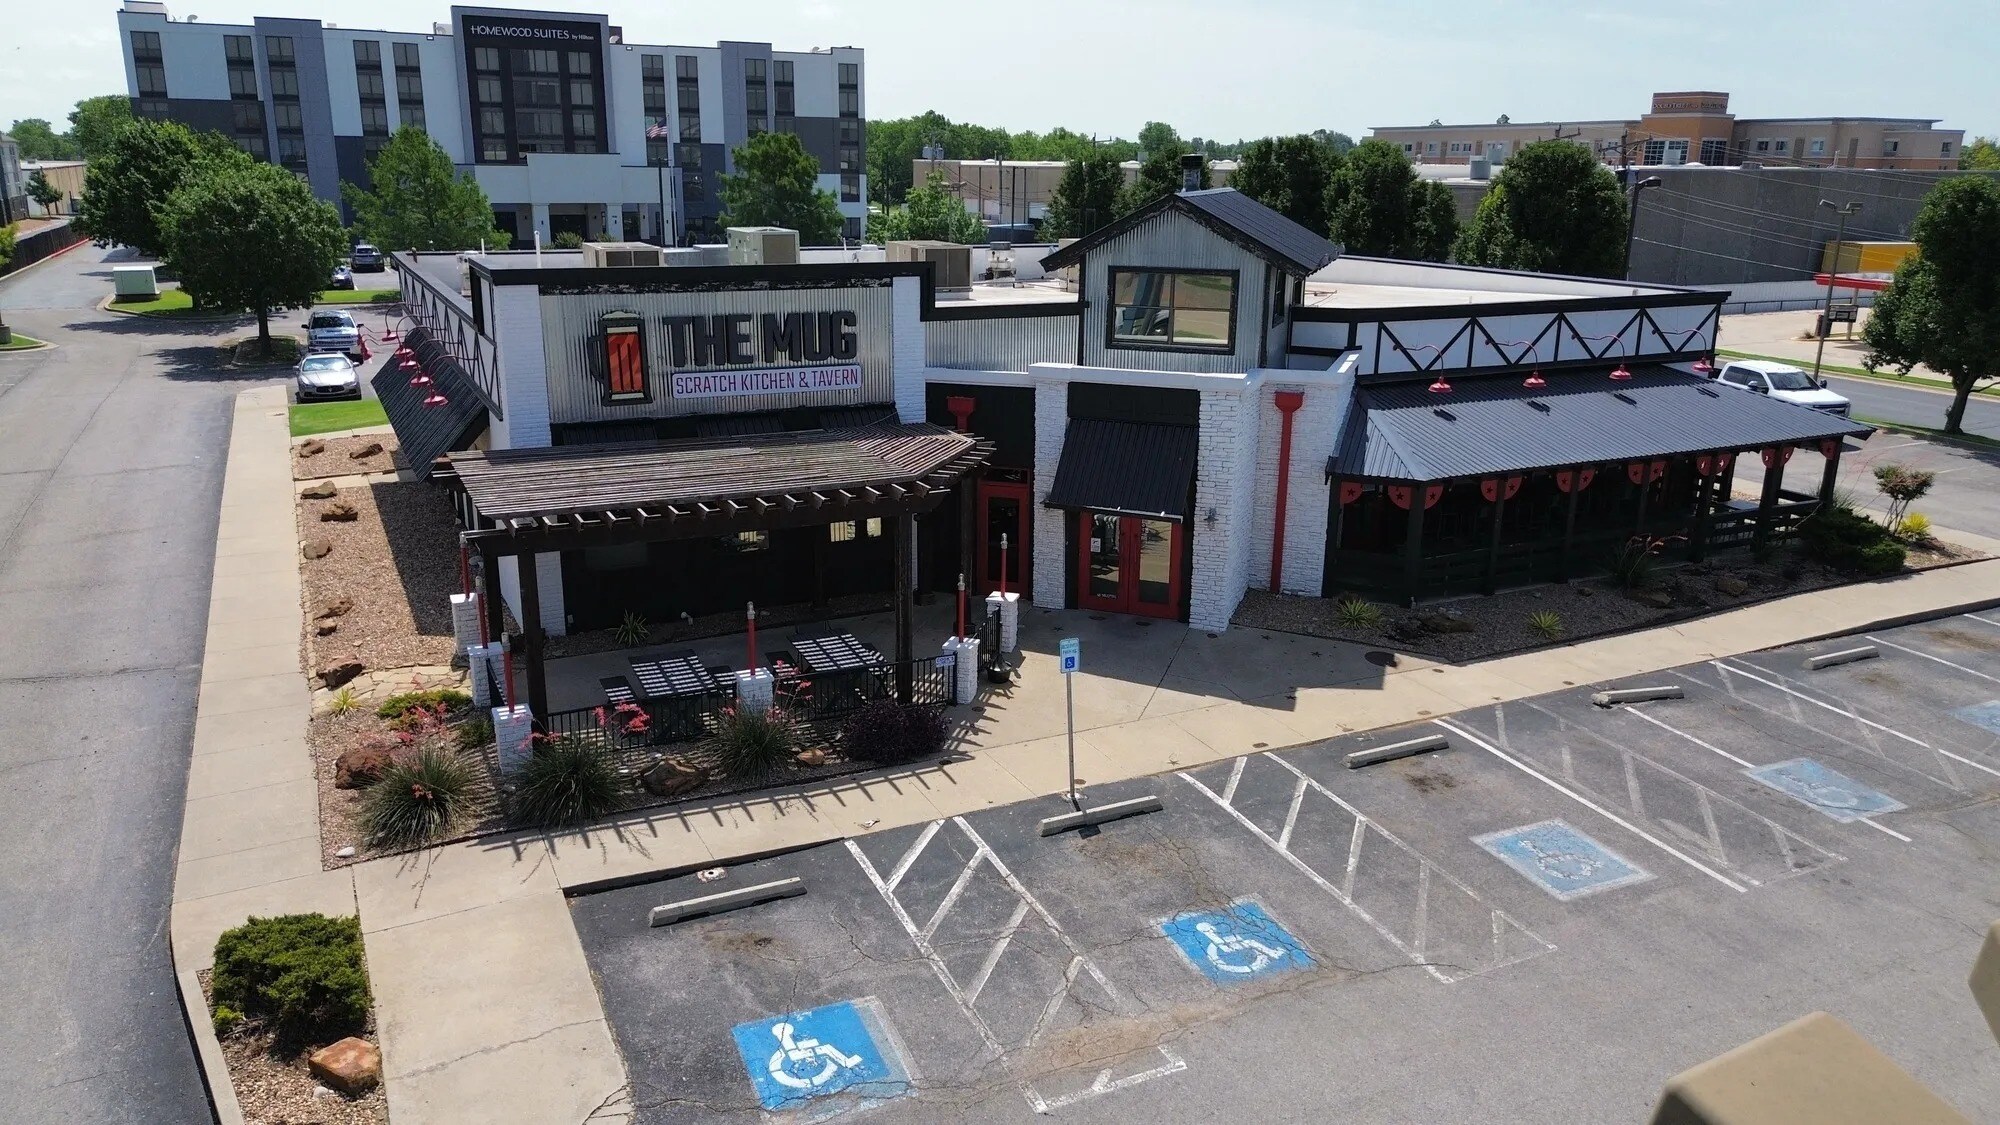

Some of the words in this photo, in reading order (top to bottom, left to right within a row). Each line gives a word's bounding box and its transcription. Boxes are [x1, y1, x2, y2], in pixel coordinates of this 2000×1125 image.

[470, 25, 532, 37] HOMEWOOD
[534, 28, 570, 40] SUITES
[662, 313, 755, 368] THE
[763, 310, 857, 363] MUG
[676, 374, 737, 395] SCRATCH
[740, 370, 795, 391] KITCHEN
[799, 371, 810, 389] &
[811, 368, 858, 386] TAVERN
